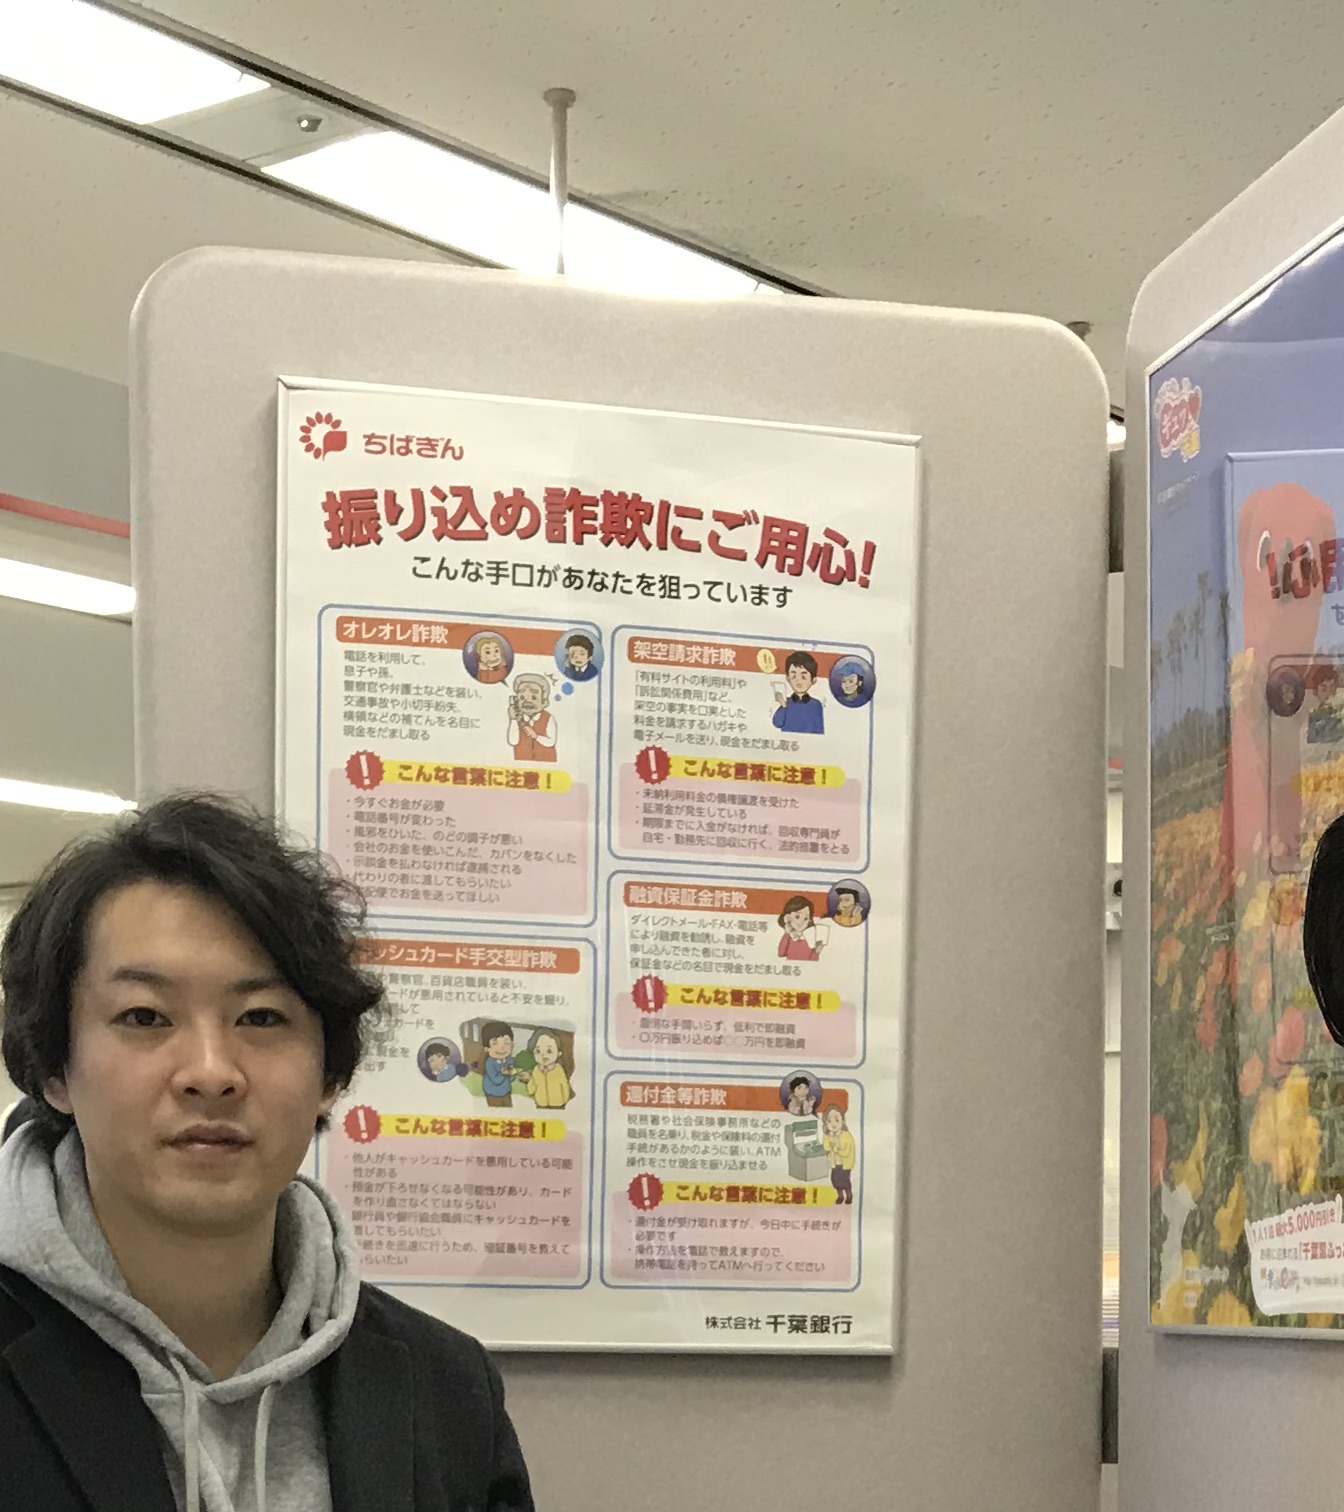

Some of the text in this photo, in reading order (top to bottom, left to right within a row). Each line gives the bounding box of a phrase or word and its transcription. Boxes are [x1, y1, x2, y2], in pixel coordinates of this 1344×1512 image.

[362, 432, 465, 461] ちばぎん
[320, 484, 877, 588] 振り込め詐欺にご用心!
[412, 555, 794, 608] こんな手口があなたを狙っています
[342, 620, 449, 644] オレオレ詐欺
[343, 649, 426, 666] 電話を利用して、
[633, 640, 736, 666] 架空請求詐欺
[397, 764, 552, 789] こんな言葉に注意！
[683, 759, 828, 785] こんな言葉に注意！
[629, 885, 748, 910] 融資保証金詐欺
[680, 988, 823, 1010] こんな言葉に注意！
[625, 1085, 727, 1106] 還付金等詐欺
[395, 1117, 547, 1139] こんな言葉に注意！
[675, 1184, 819, 1205] こんな言葉に注意！
[705, 1314, 853, 1334] 株式会社 千葉銀行
